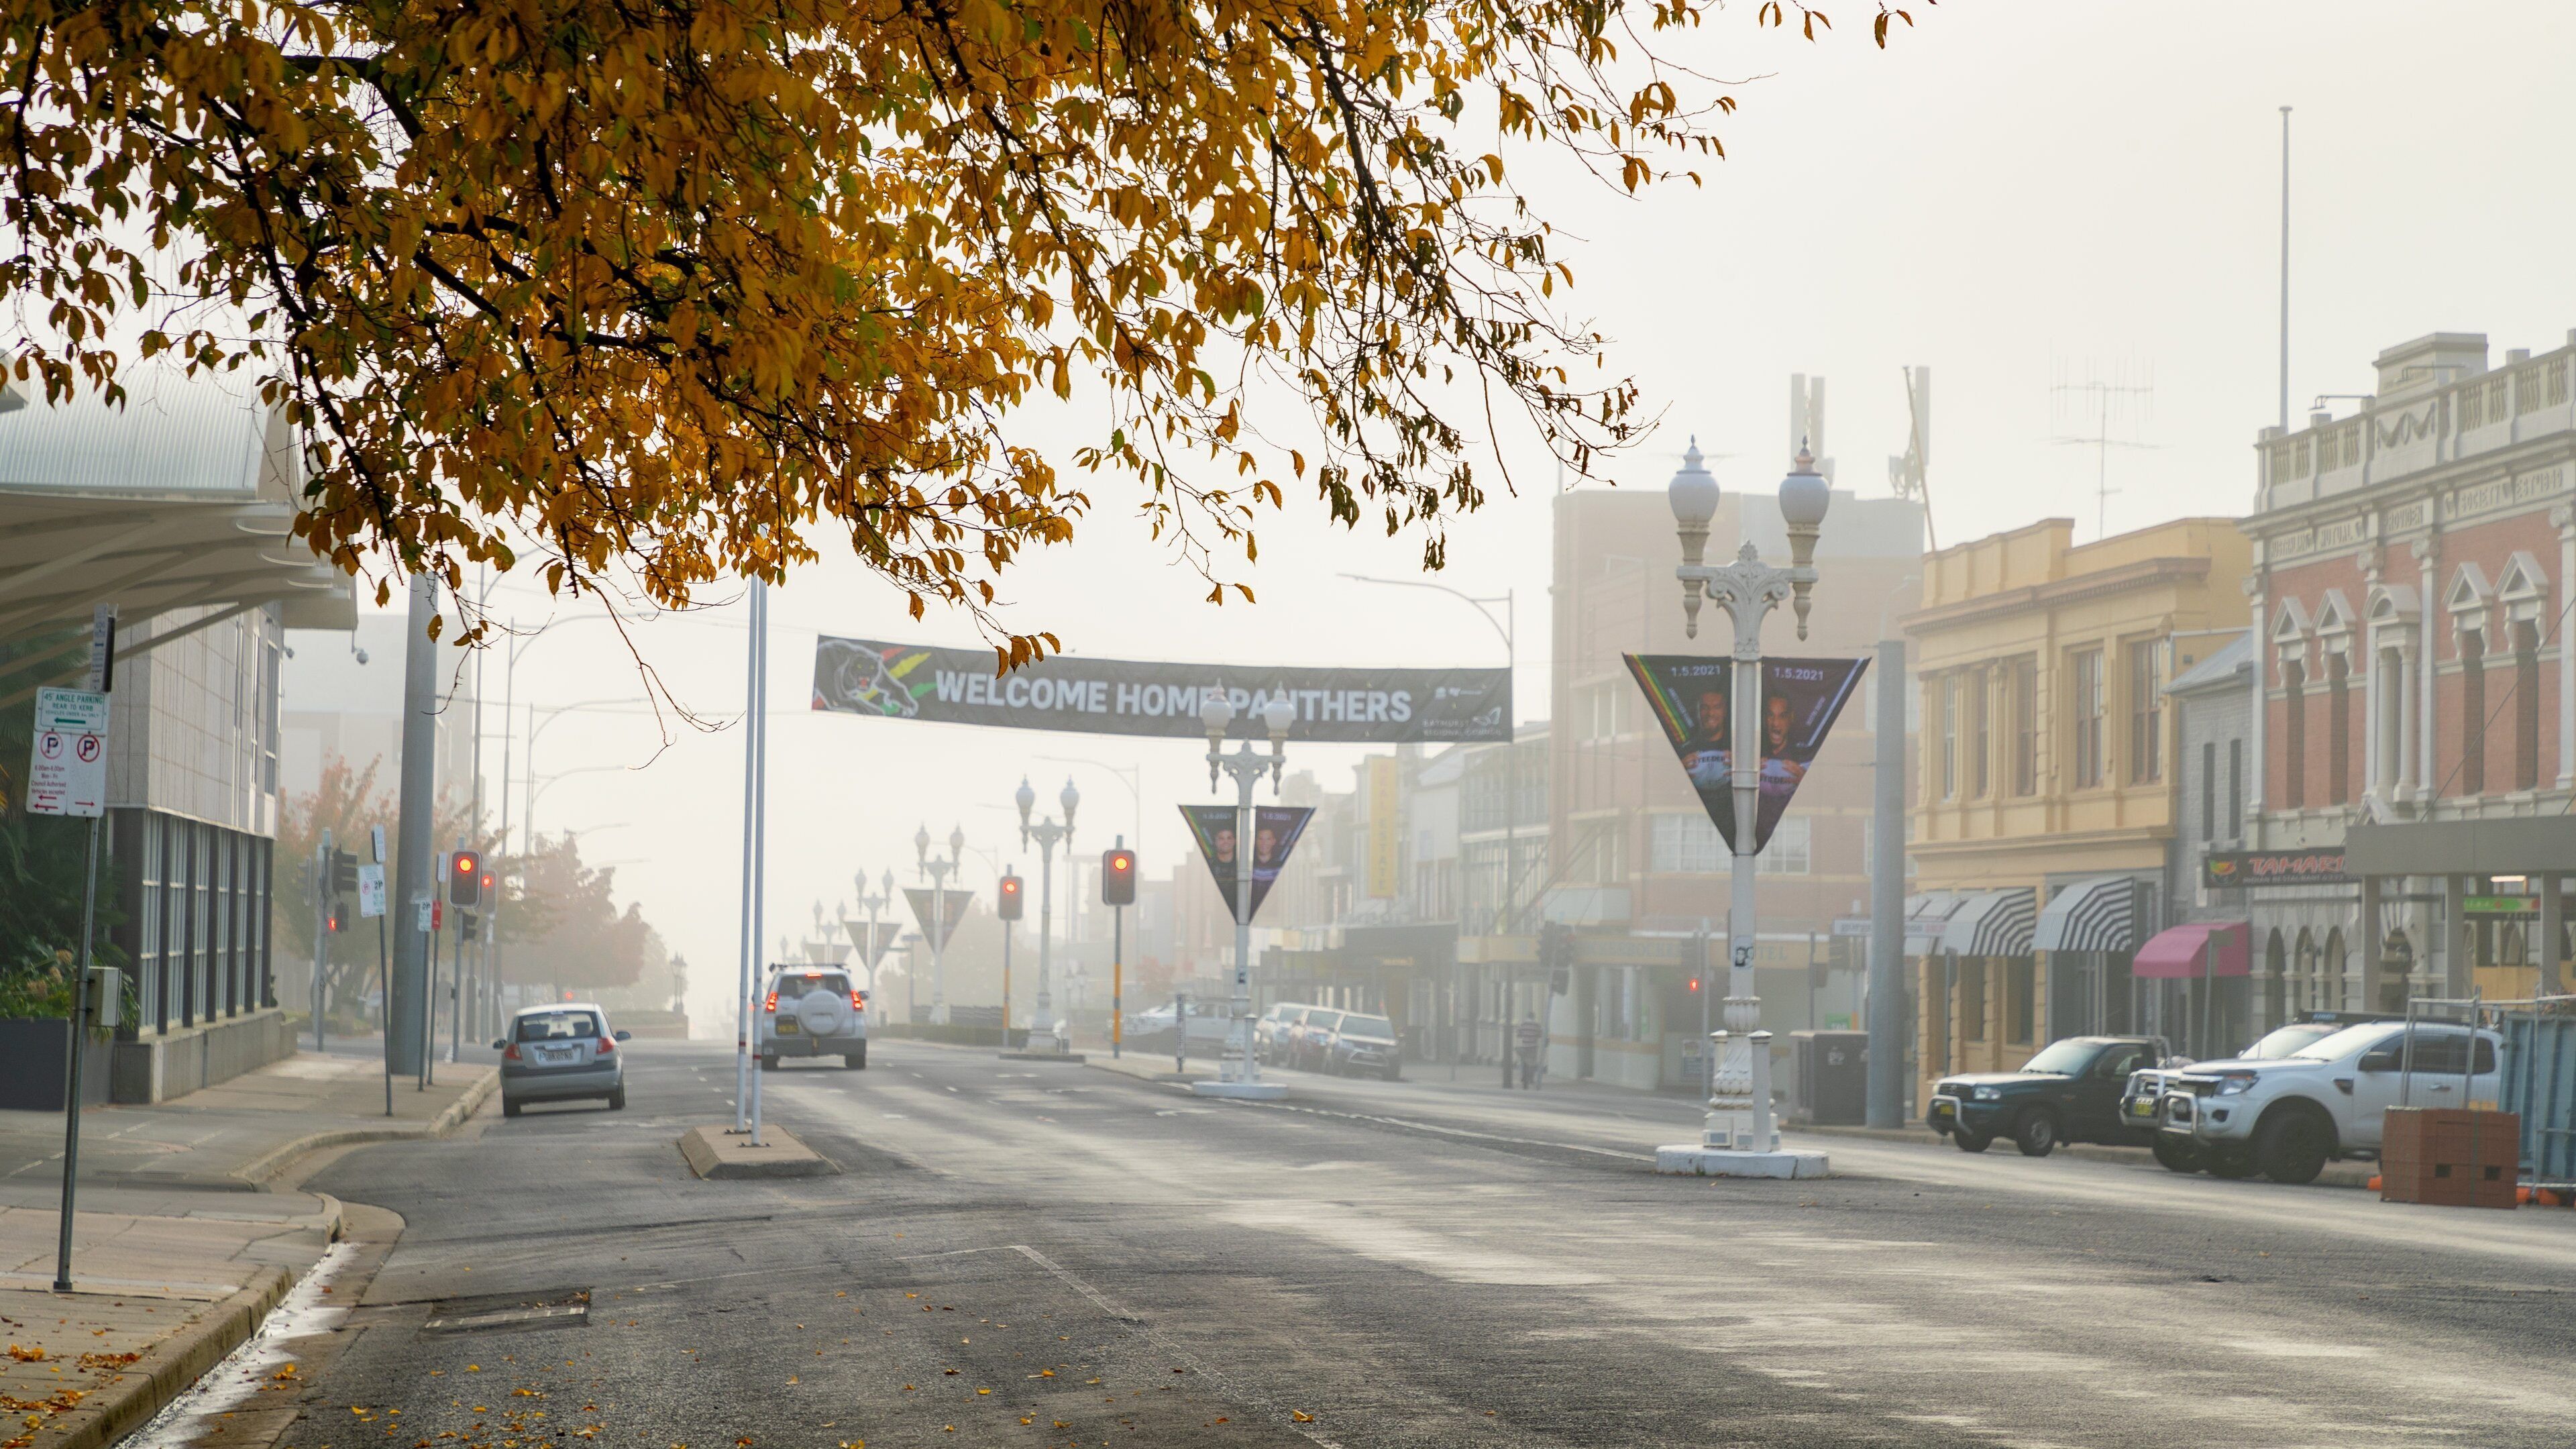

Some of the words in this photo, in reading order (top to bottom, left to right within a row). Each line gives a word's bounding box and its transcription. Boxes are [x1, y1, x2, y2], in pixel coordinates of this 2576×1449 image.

[2320, 524, 2353, 547] MUTUAL
[2461, 484, 2501, 512] SOCIETY
[1670, 664, 1721, 678] 1.5.2021
[1773, 667, 1824, 682] 1.5.2021
[934, 669, 1109, 714] WELCOME
[56, 694, 75, 702] ANGLE
[76, 695, 103, 705] PARKING
